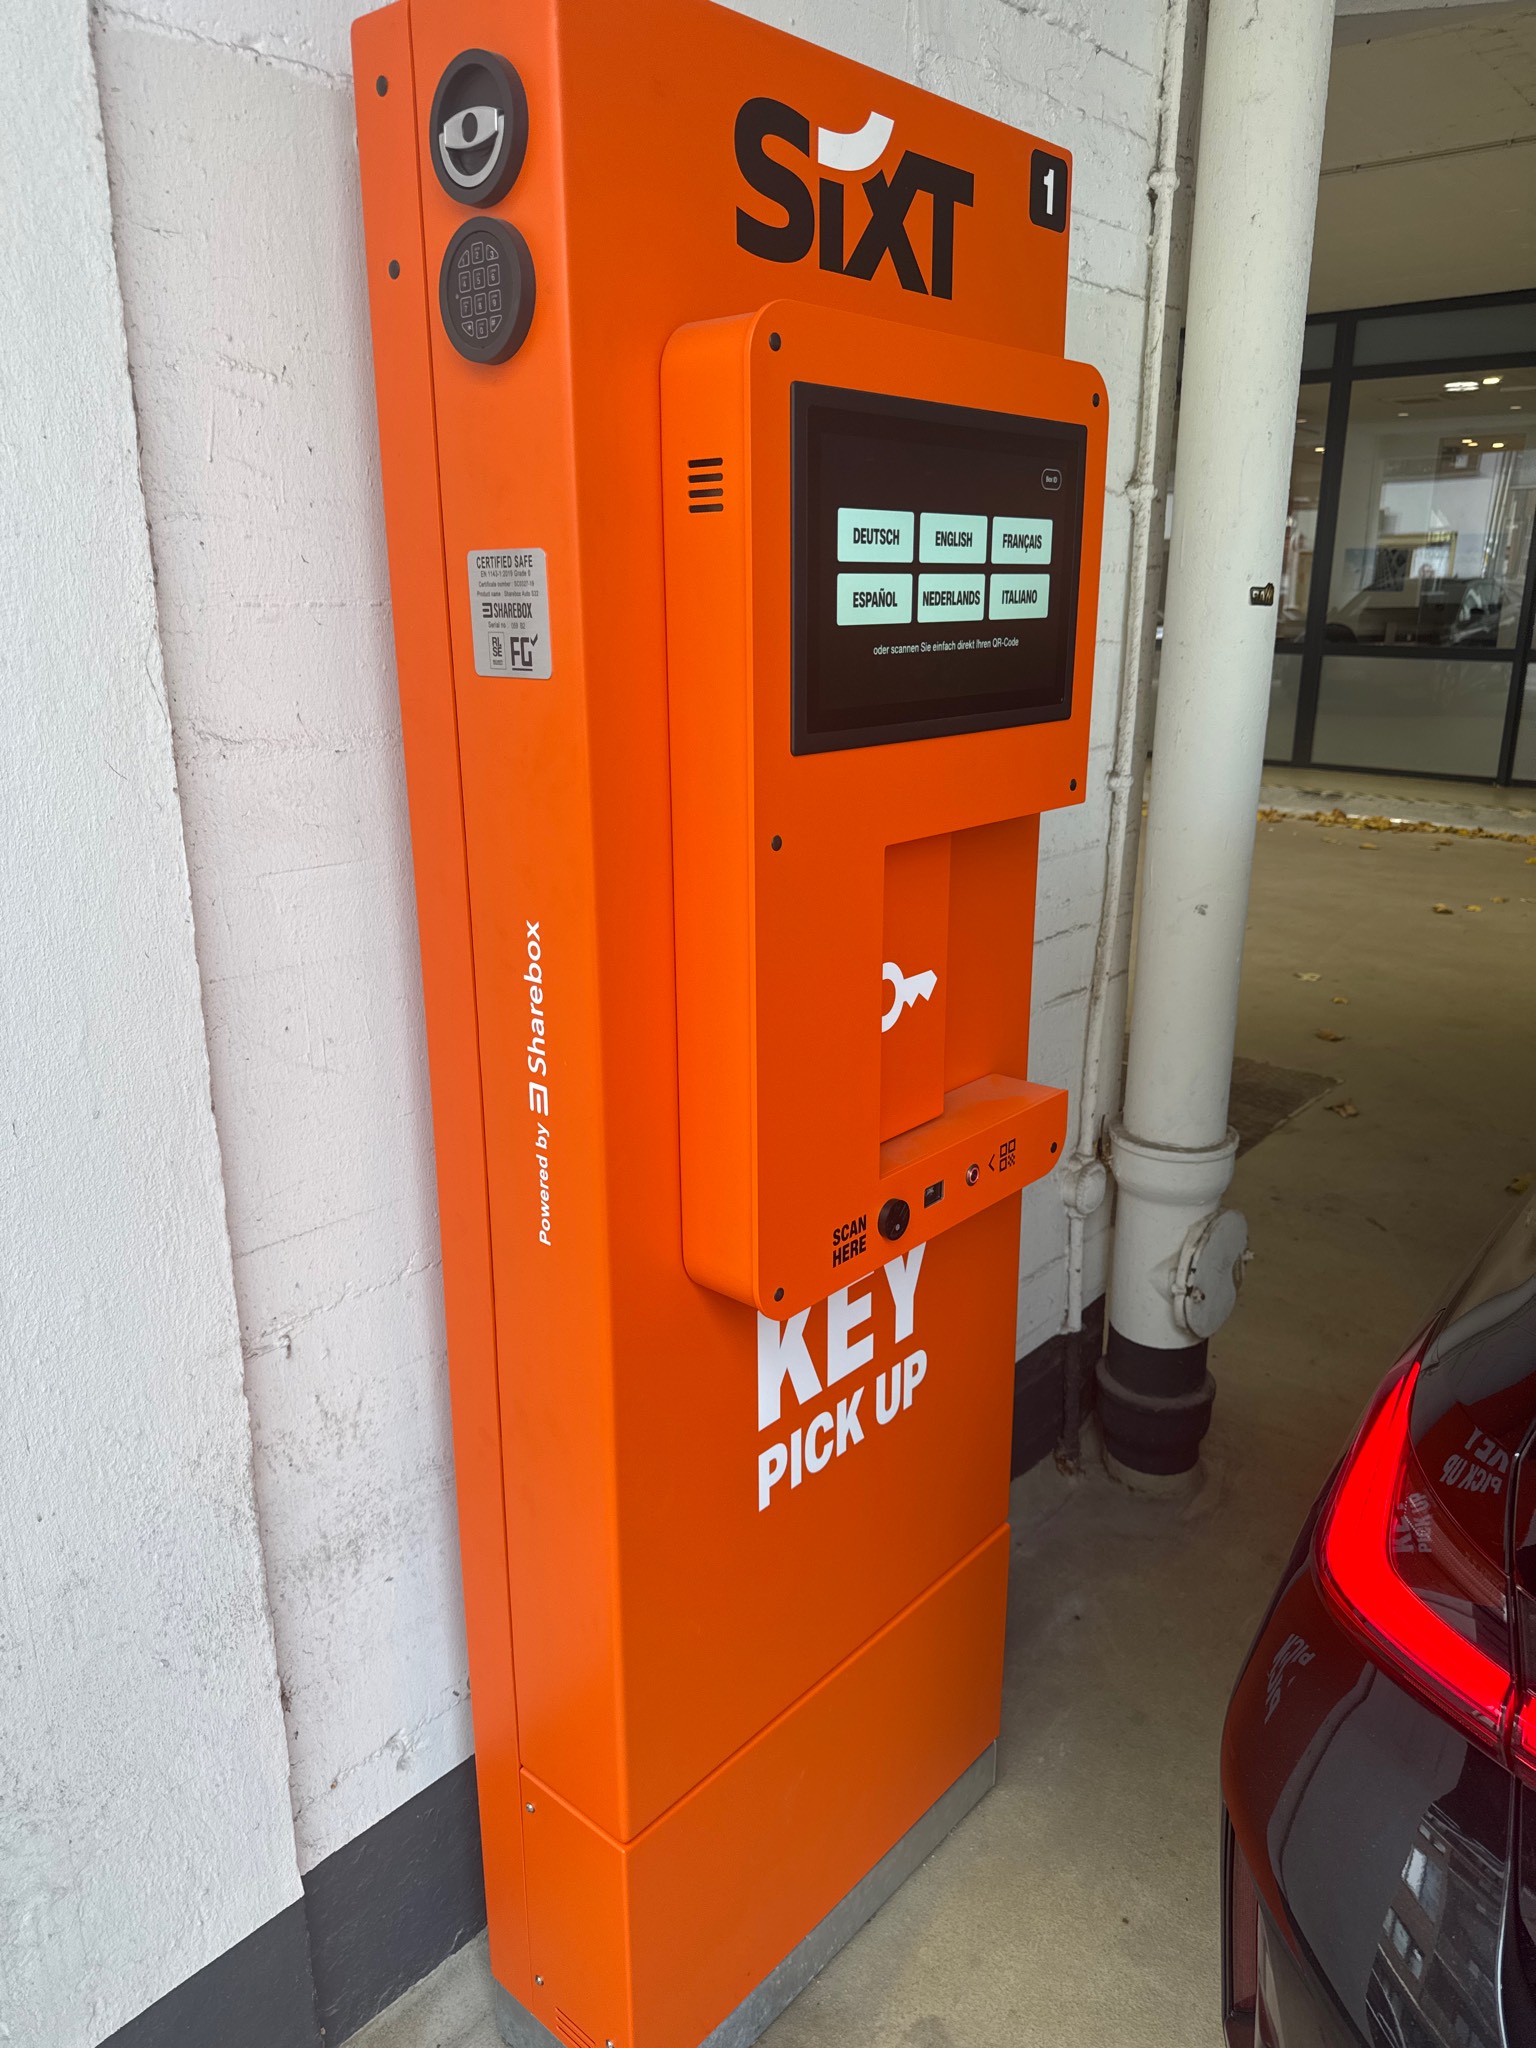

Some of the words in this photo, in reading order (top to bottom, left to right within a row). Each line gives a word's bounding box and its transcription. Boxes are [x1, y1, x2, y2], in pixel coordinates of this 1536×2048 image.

[1042, 168, 1057, 216] 1
[853, 528, 900, 545] DEUTSCH
[935, 530, 973, 547] ENGLISH
[1002, 533, 1042, 553] FRANÇAIS
[476, 556, 512, 569] CERTIFIED
[514, 555, 533, 568] SAFE
[853, 588, 898, 608] ESPAÑOL
[922, 590, 981, 607] NEDERLANDS
[1001, 589, 1038, 605] ITALIANO
[494, 603, 532, 618] SHAREBOX
[873, 645, 889, 655] oder
[891, 644, 919, 654] scannen
[921, 642, 931, 652] Sie
[932, 640, 956, 652] einfach
[957, 639, 975, 650] direkt
[976, 638, 991, 649] Ihren
[992, 637, 1019, 648] QR-Code
[523, 919, 547, 1078] Sharebox
[535, 1122, 550, 1153] by
[535, 1153, 552, 1247] Powered
[832, 1214, 867, 1247] SCAN
[832, 1238, 867, 1268] HERE
[757, 1241, 927, 1432] KEY
[758, 1386, 865, 1512] PICK
[875, 1350, 928, 1426] UP
